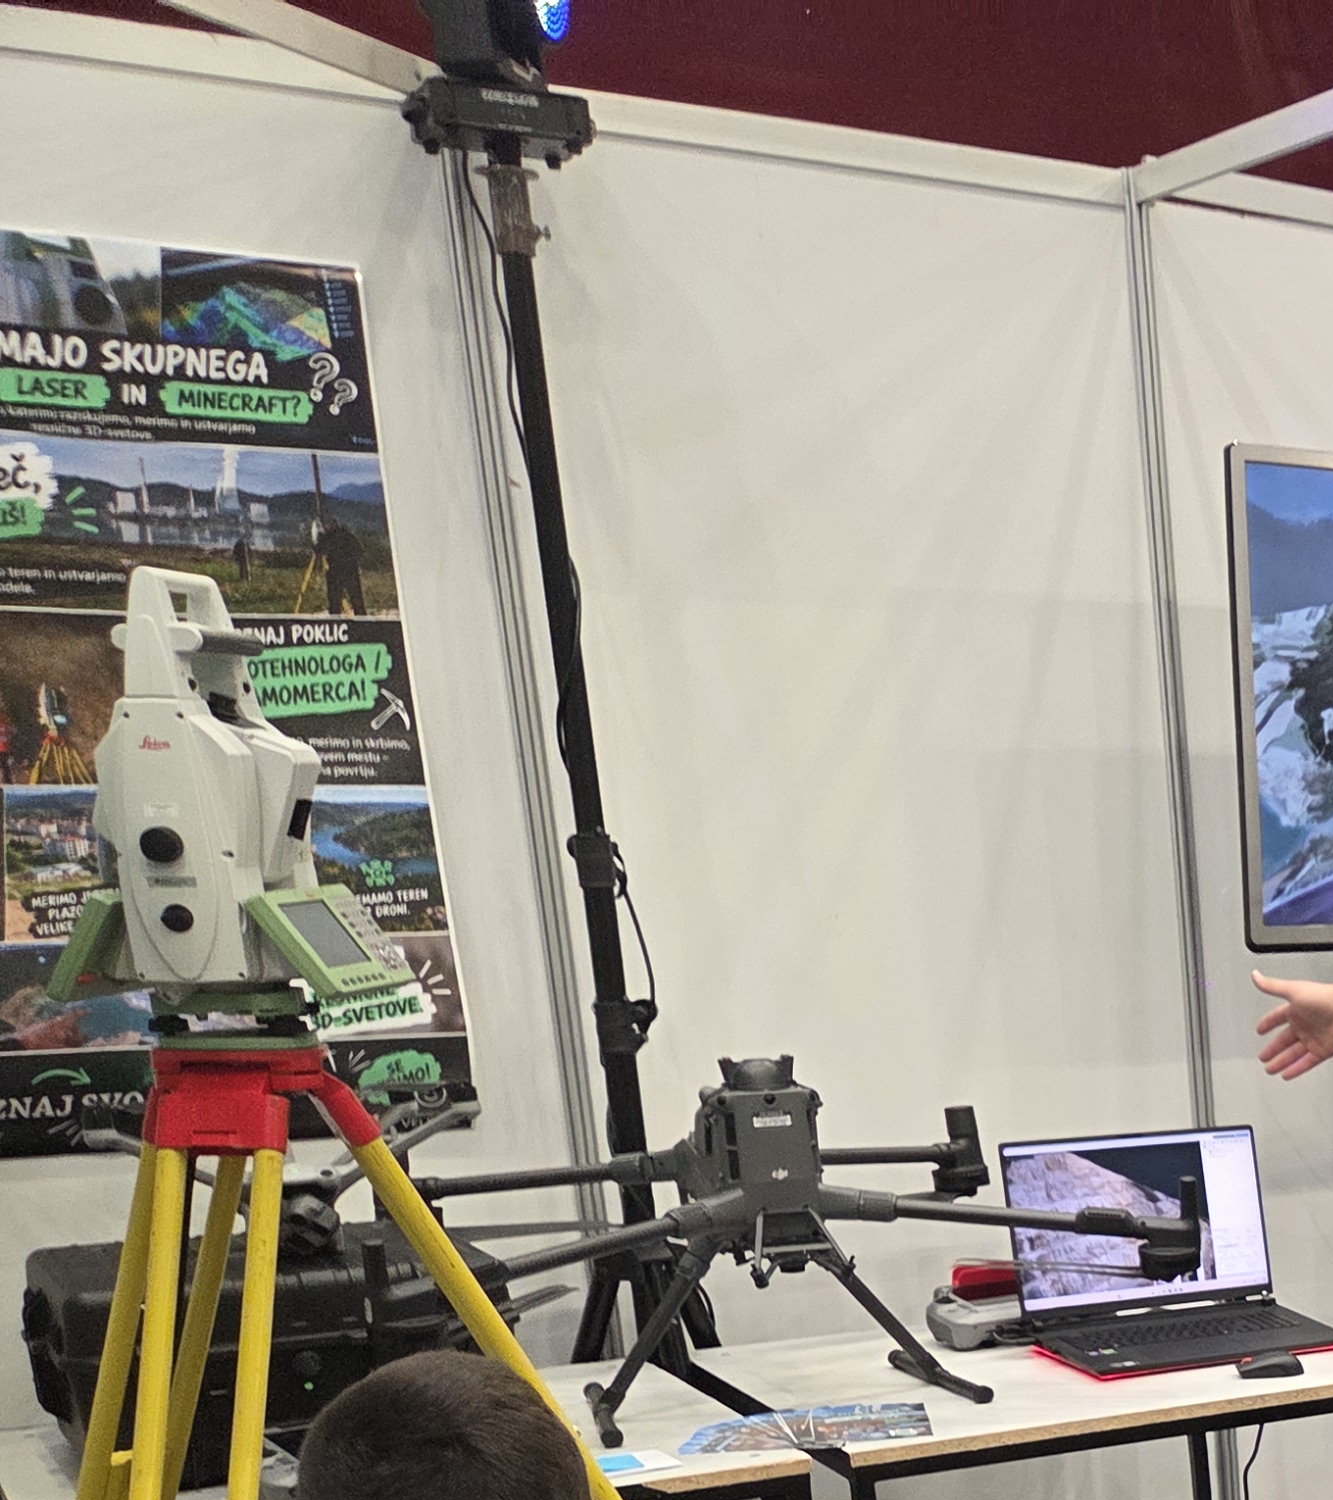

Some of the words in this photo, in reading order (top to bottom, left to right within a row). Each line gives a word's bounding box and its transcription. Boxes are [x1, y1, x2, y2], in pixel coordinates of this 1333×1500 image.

[101, 338, 269, 384] SKUPNEGA
[16, 375, 88, 400] LASER
[121, 383, 146, 406] IN
[177, 388, 301, 417] MINECRAFT?
[291, 623, 349, 643] POKLIC
[32, 892, 78, 908] MERIMO
[397, 888, 429, 902] TEREN
[375, 904, 411, 918] DRONI.
